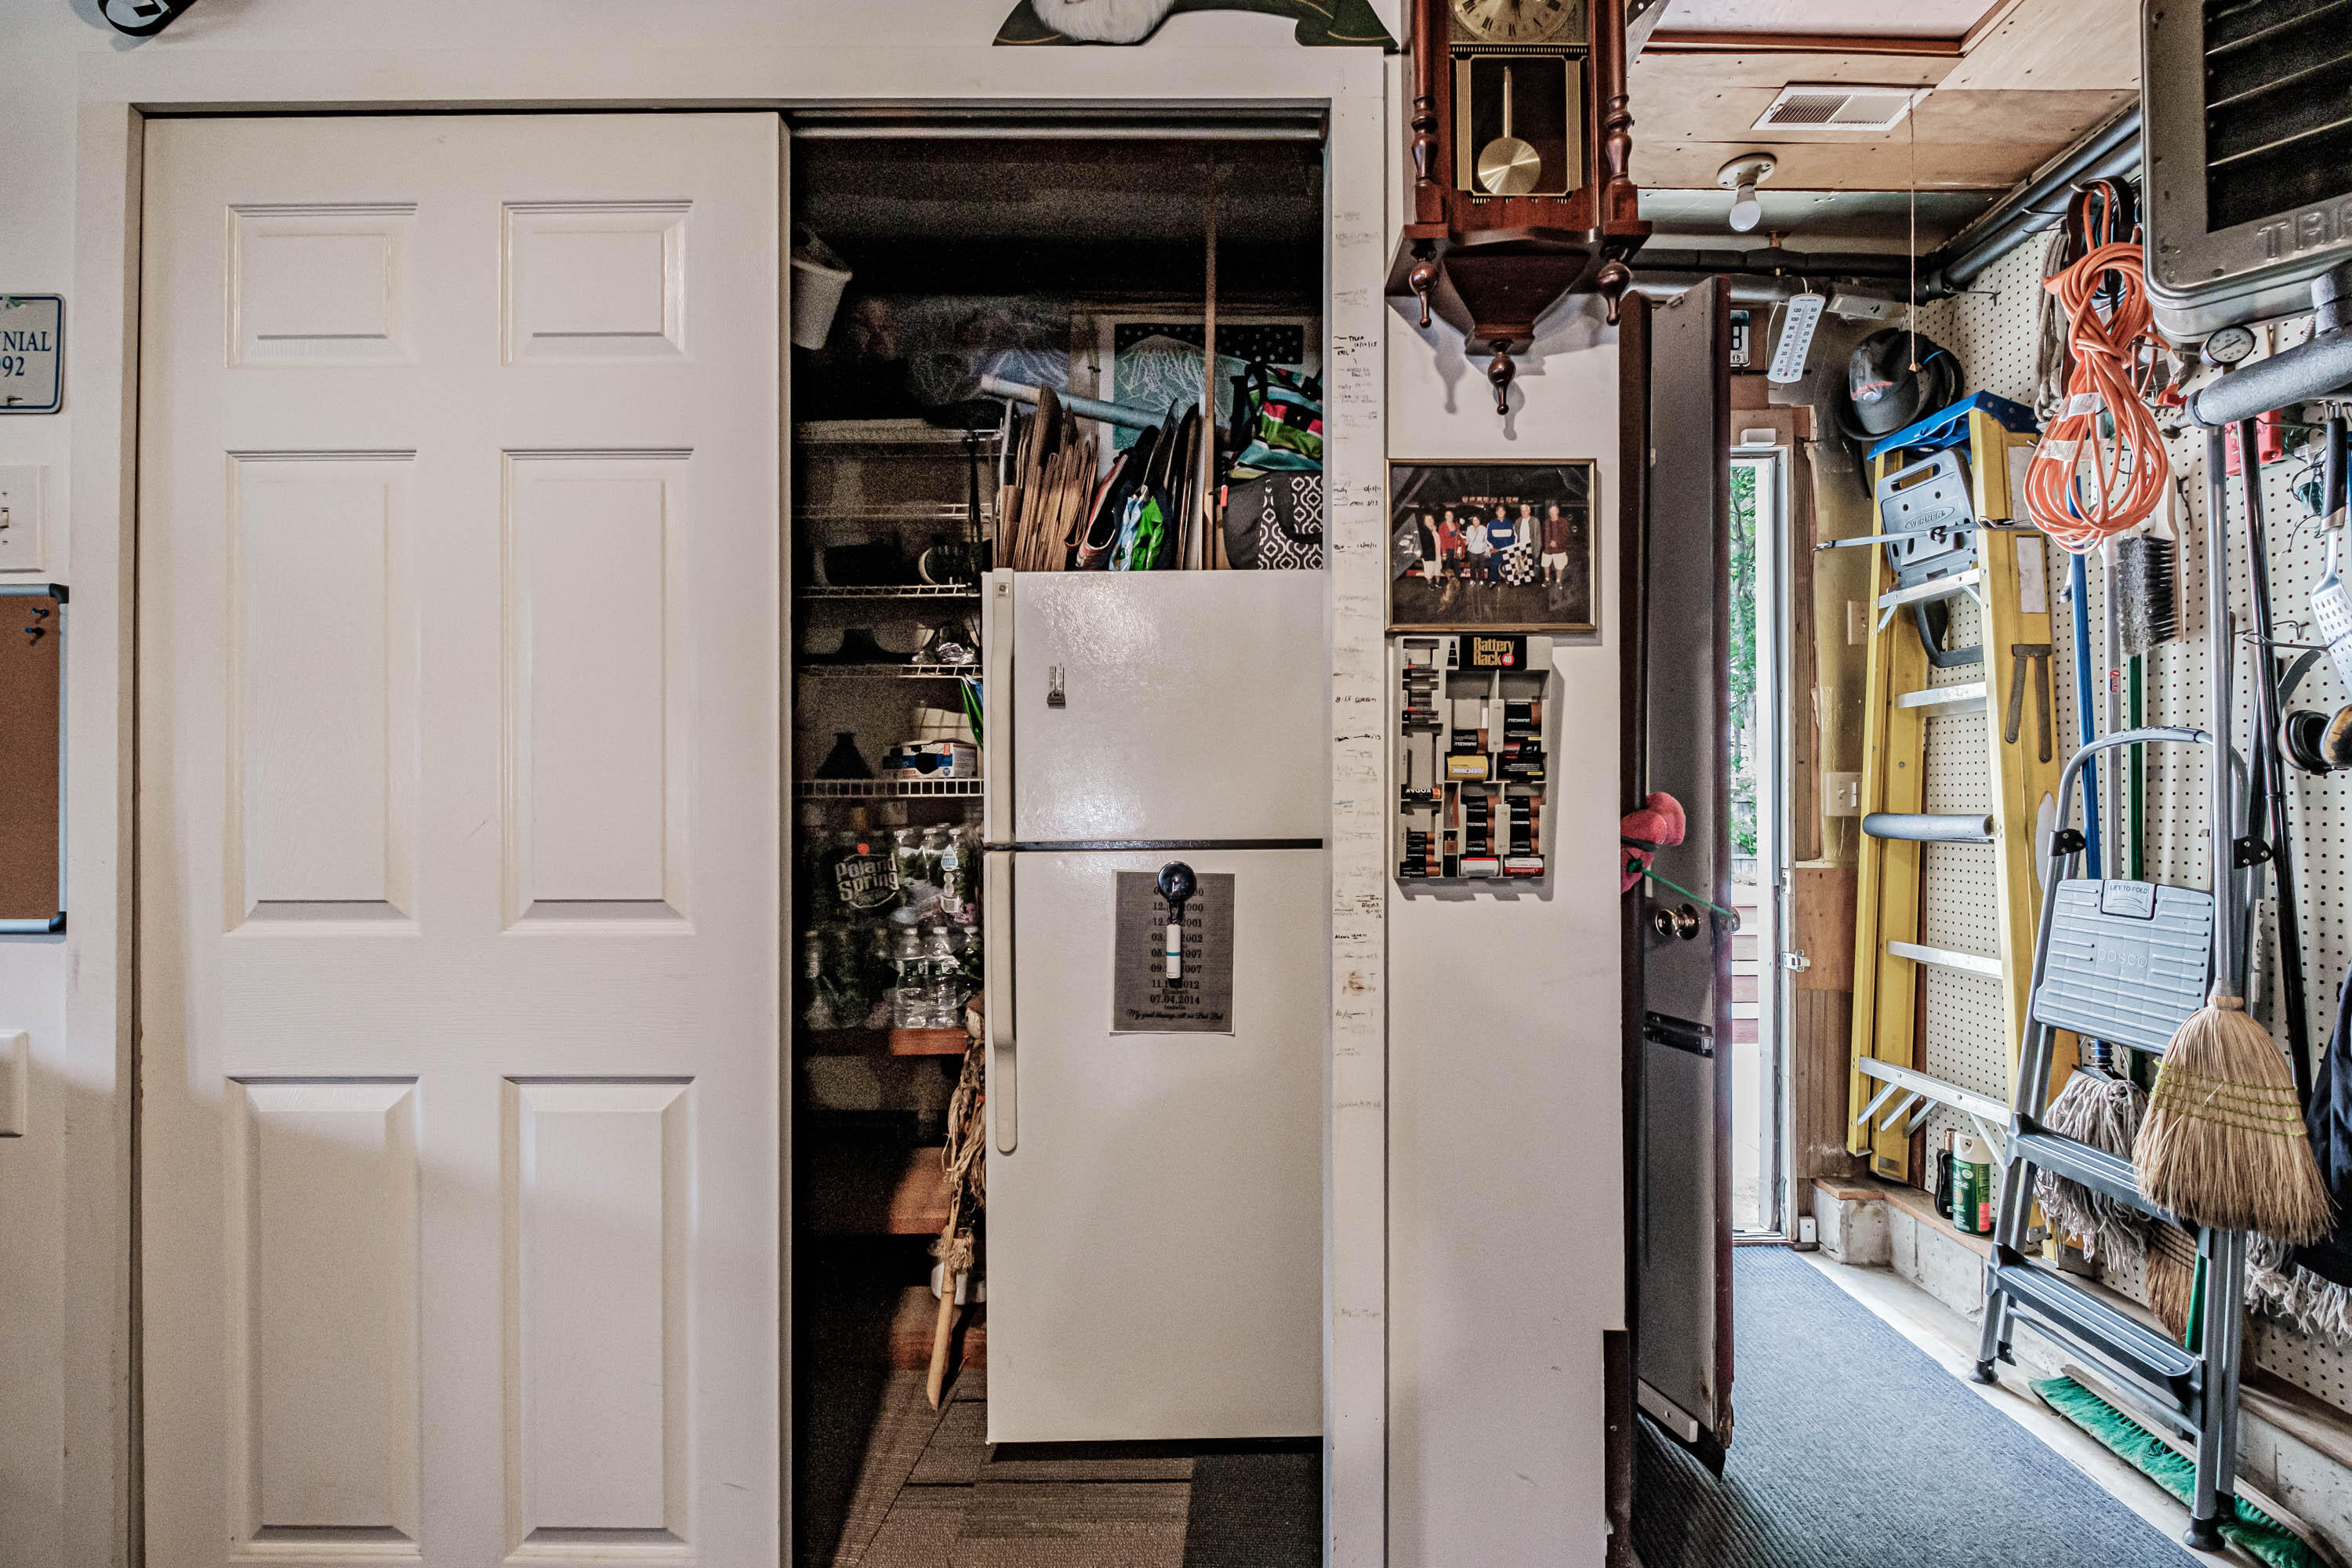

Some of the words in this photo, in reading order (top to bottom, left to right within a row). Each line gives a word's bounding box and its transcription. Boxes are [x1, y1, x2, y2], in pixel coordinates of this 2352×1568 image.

[0, 331, 52, 352] NIAL
[0, 355, 25, 377] 92
[1910, 510, 1944, 528] WERNER
[1474, 637, 1515, 655] Battery
[1474, 651, 1502, 665] Rack
[835, 853, 897, 883] Poland
[837, 872, 900, 901] Spring
[2098, 948, 2148, 968] COSCO
[1150, 994, 1200, 1004] 07.04.2014
